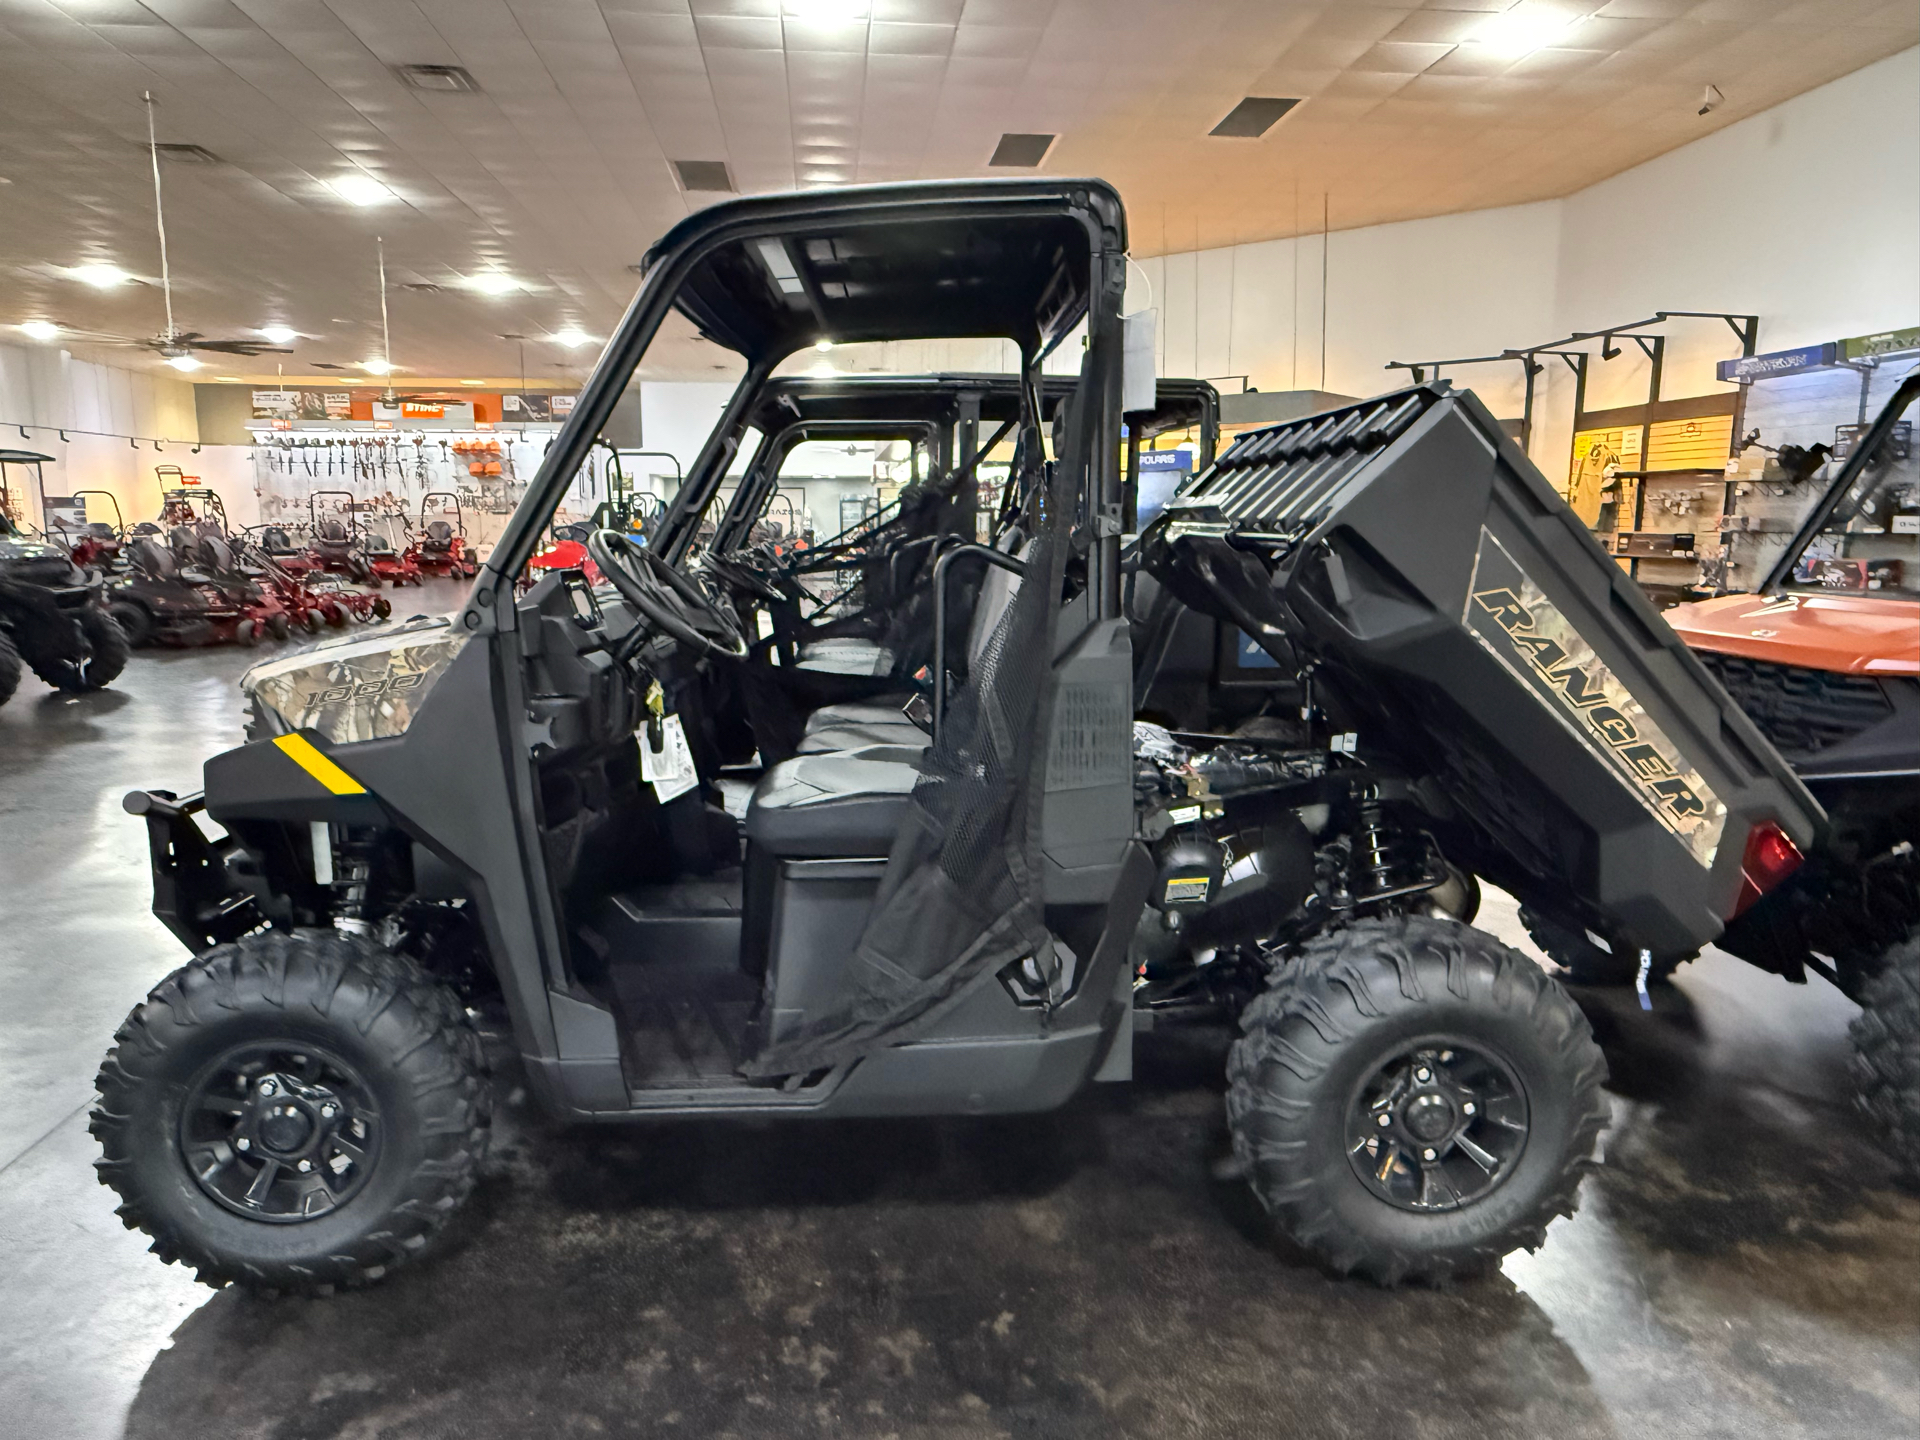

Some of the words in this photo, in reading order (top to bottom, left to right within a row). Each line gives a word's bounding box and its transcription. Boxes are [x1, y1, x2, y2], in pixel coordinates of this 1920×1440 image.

[1139, 453, 1176, 465] POLARIS
[303, 672, 426, 707] 1000
[1472, 587, 1707, 820] RANGER
